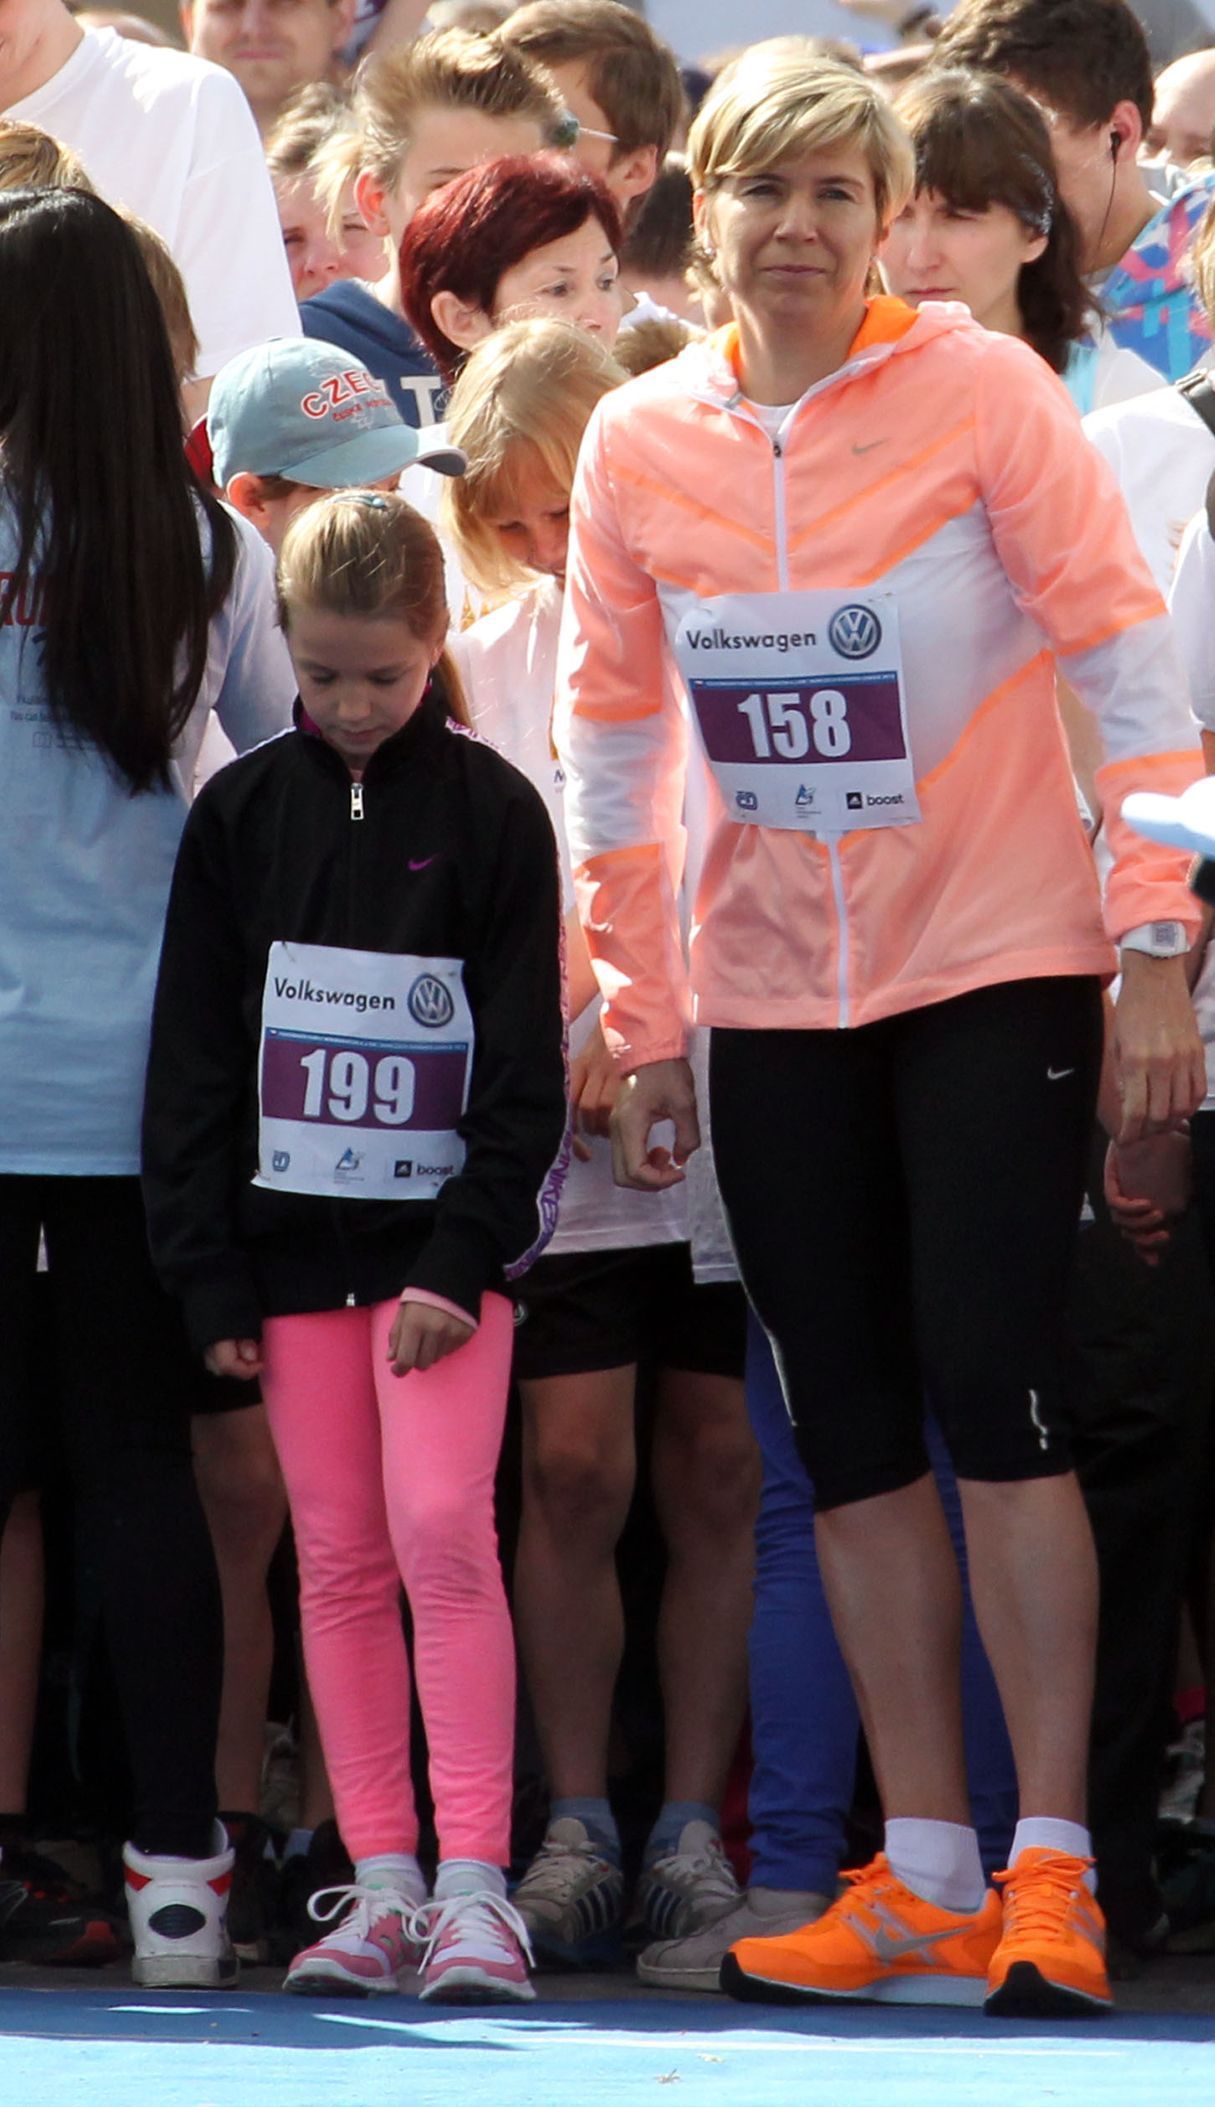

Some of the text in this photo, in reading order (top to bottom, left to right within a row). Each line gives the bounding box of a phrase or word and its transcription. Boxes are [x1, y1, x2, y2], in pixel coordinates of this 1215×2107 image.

[686, 630, 817, 653] Volkswagen
[737, 689, 852, 759] 158
[866, 794, 904, 806] boost
[274, 977, 395, 1012] Volkswagen
[301, 1049, 416, 1125] 199
[416, 1163, 453, 1176] boost
